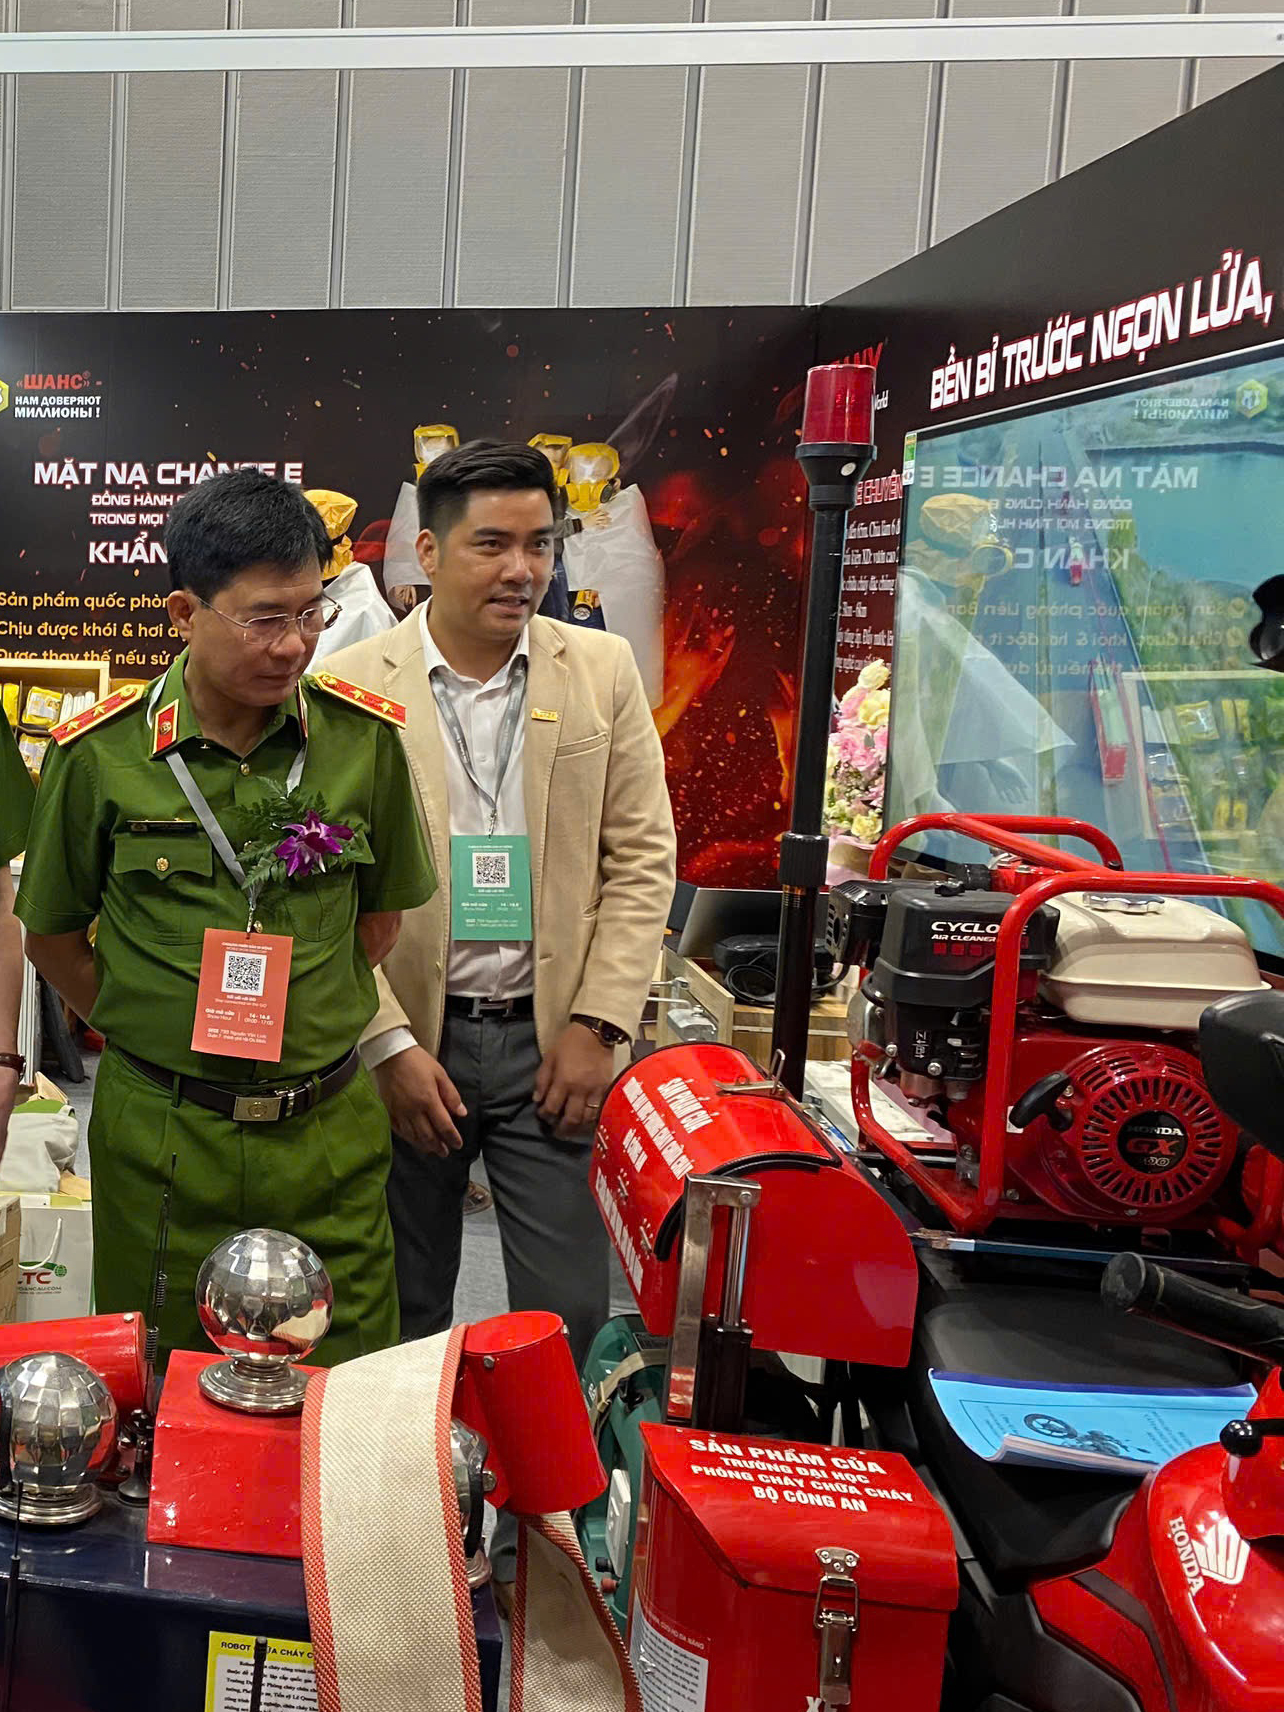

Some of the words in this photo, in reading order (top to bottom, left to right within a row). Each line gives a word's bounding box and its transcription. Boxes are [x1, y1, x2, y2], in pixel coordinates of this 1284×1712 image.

[974, 333, 1000, 398] BỈ
[1002, 312, 1086, 388] TRƯỚC
[1089, 283, 1184, 366] NGỌN
[1189, 247, 1274, 337] LỬA,
[16, 396, 38, 406] НАМ
[40, 396, 101, 406] ДОВЕРЯЮТ
[15, 407, 92, 418] МИЛЛИОНЫ
[34, 459, 97, 490] MẶT
[105, 462, 149, 490] NẠ
[284, 462, 304, 484] E
[92, 490, 130, 506] ĐỒNG
[133, 492, 173, 506] HÀNH
[90, 513, 136, 525] TRONG
[139, 513, 164, 527] MỌI
[89, 531, 168, 564] KHẨN
[32, 590, 80, 610] phẩm
[84, 592, 126, 611] quốc
[37, 622, 78, 640] được
[83, 622, 117, 637] khói
[122, 624, 134, 638] &
[138, 623, 163, 638] hơi
[116, 650, 146, 665] nếu
[150, 650, 175, 665] sử
[931, 921, 1028, 935] CYCLOE
[1127, 1139, 1180, 1156] GX
[18, 1272, 52, 1285] TC
[689, 1436, 744, 1456] SẢN
[748, 1447, 826, 1467] PHẨM
[831, 1455, 887, 1474] CỦA
[720, 1457, 793, 1474] TRƯỜNG
[797, 1467, 828, 1480] ĐẠI
[833, 1472, 870, 1484] HỌC
[690, 1465, 754, 1482] PHÒNG
[758, 1473, 805, 1488] CHÁY
[810, 1480, 862, 1496] CHỮA
[865, 1487, 914, 1502] CHÁY
[752, 1485, 778, 1504] BỘ
[783, 1489, 836, 1508] CÔNG
[840, 1497, 868, 1512] AN
[1168, 1516, 1205, 1596] HONDA
[221, 1642, 252, 1652] ROBOT
[280, 1648, 304, 1658] CHÁY
